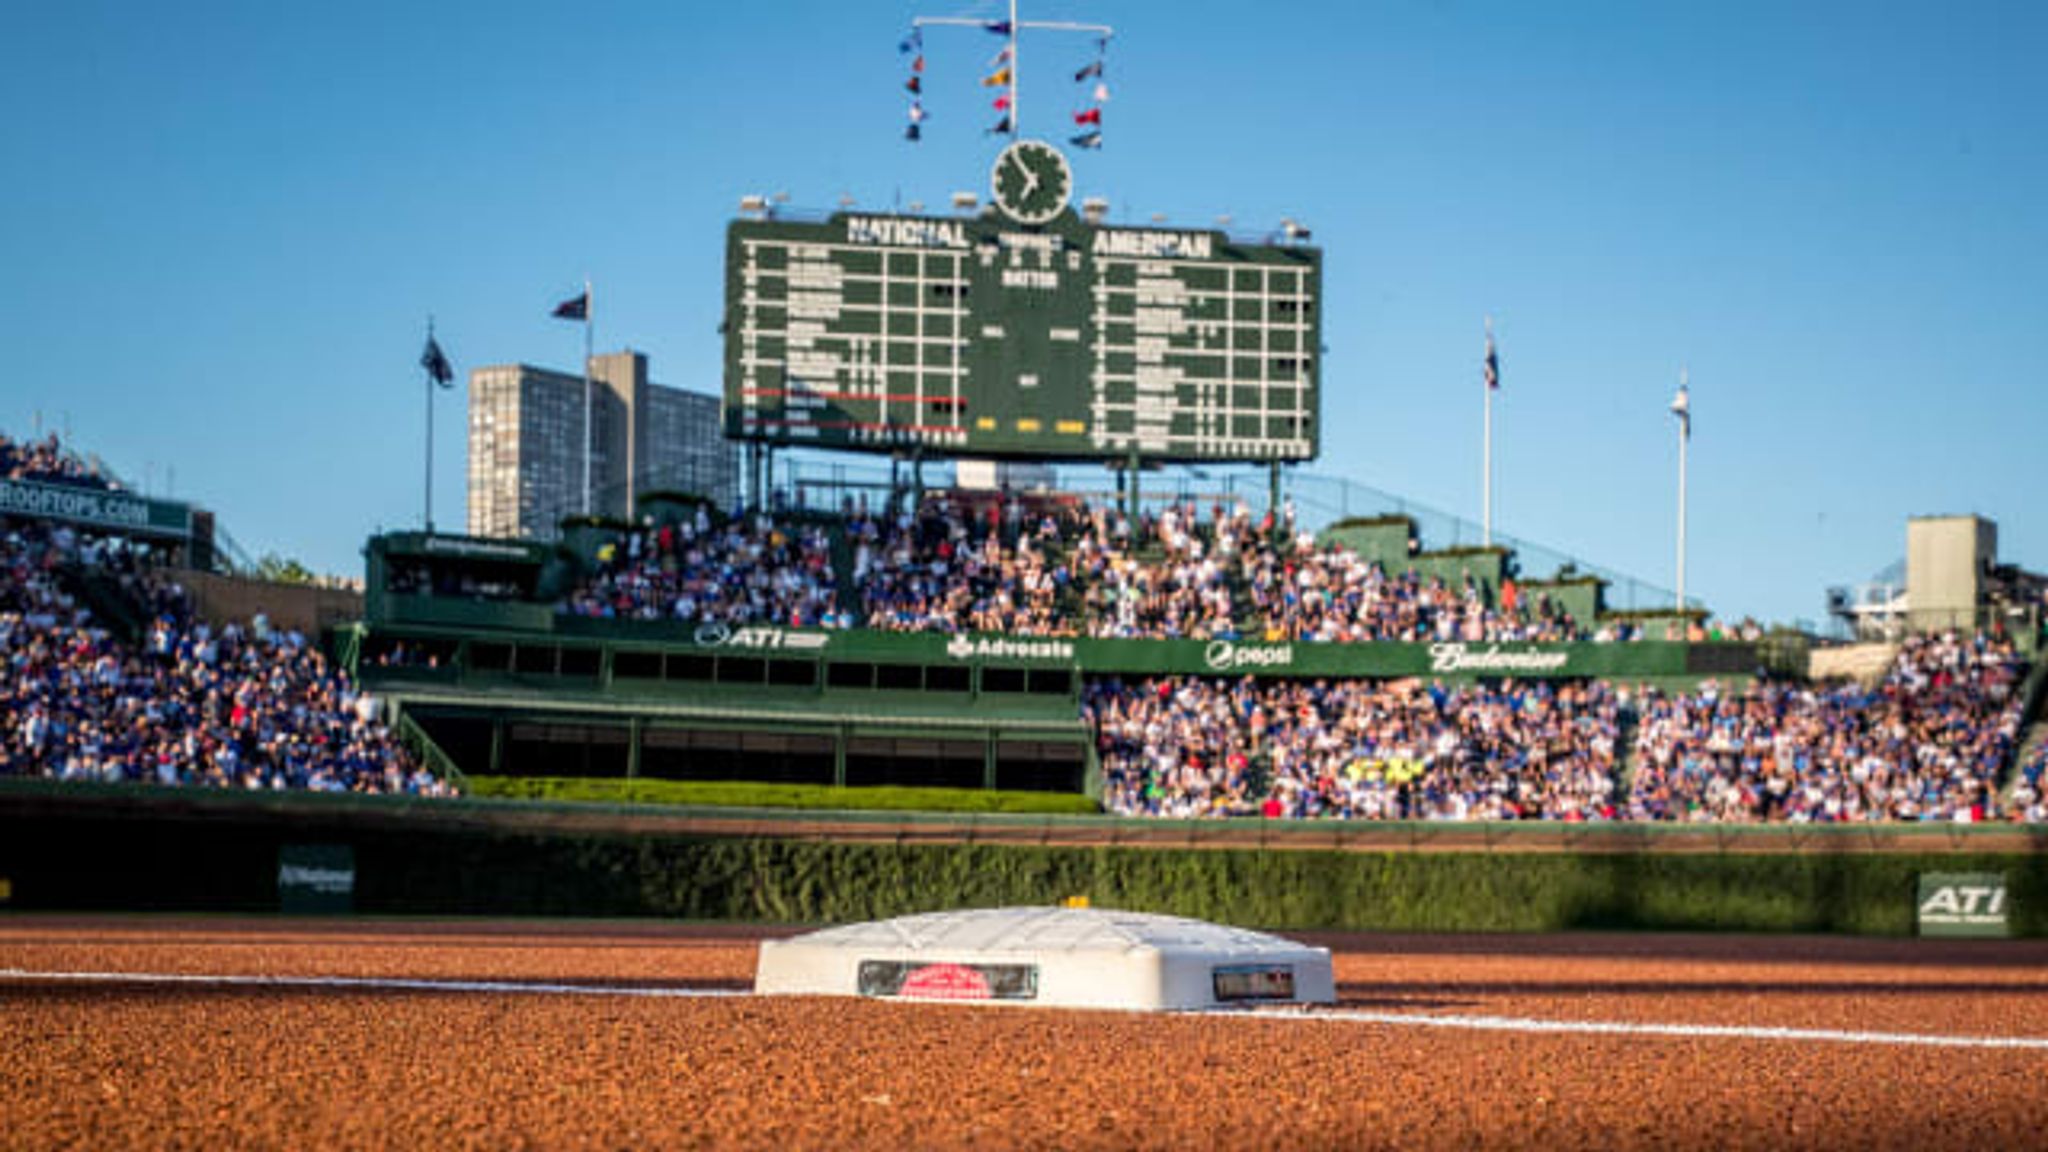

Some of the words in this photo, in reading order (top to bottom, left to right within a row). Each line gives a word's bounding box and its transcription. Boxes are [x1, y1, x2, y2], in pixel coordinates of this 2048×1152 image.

[848, 216, 970, 248] NATIONAL
[1092, 230, 1211, 258] AMERICAN
[729, 627, 783, 649] ATI
[977, 638, 1074, 658] Advocate
[1235, 643, 1292, 667] pepsi
[1429, 642, 1568, 672] Budweiser
[1920, 885, 2007, 914] ATI
